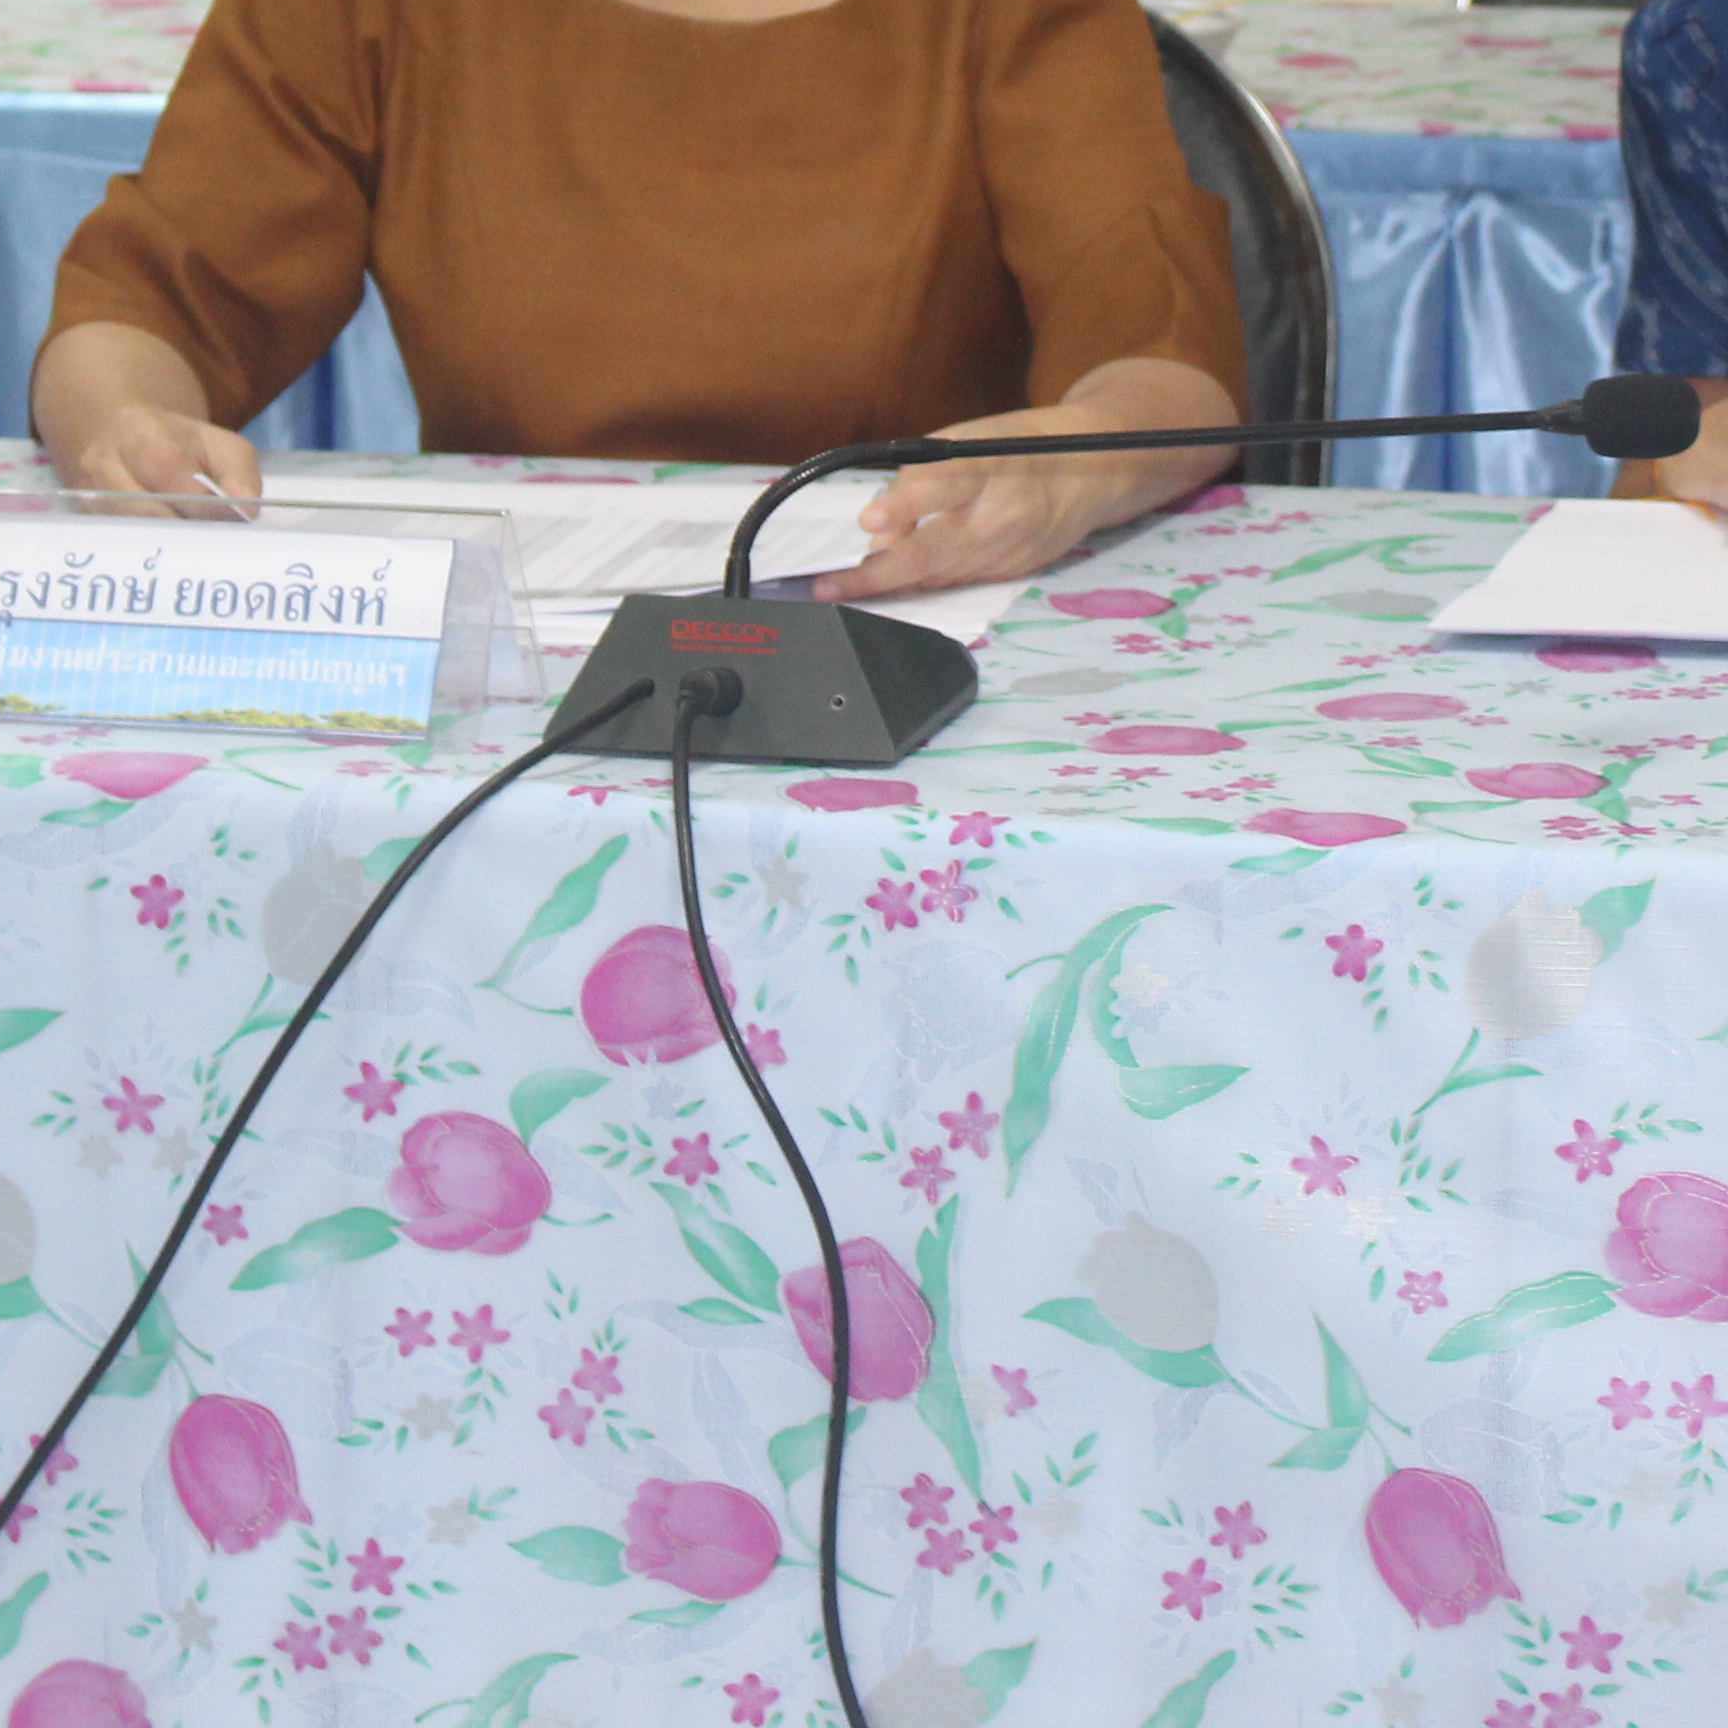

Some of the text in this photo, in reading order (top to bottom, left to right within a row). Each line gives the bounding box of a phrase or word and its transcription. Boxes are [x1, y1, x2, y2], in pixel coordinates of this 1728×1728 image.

[174, 559, 392, 627] ยอดสิงห์
[671, 619, 779, 642] DECCON
